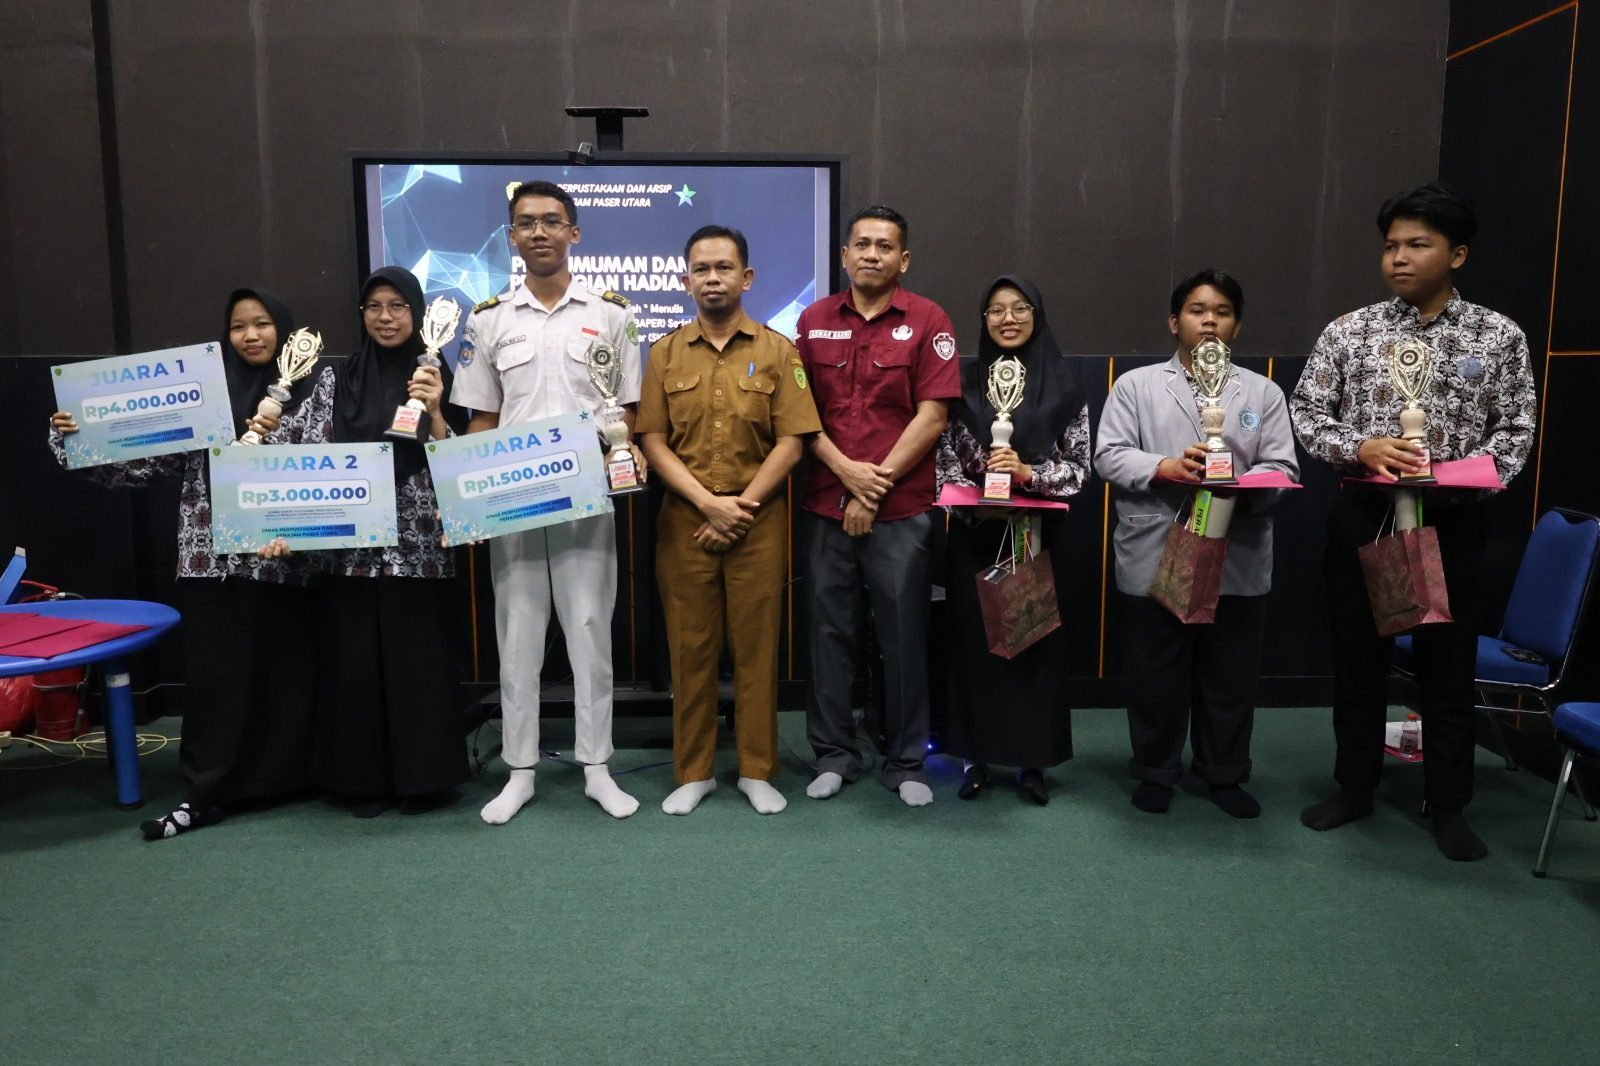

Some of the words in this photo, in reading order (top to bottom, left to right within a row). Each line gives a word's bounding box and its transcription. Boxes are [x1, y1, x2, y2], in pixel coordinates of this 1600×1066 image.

[626, 184, 646, 193] DAN
[646, 184, 673, 194] ARSIP
[593, 198, 621, 207] PASER
[622, 198, 651, 207] UTARA
[623, 275, 685, 291] HADIA
[650, 303, 684, 314] Menulis
[90, 362, 169, 386] JUARA
[176, 359, 185, 373] 1
[84, 389, 200, 419] Rp4.000.000
[462, 433, 542, 461] JUARA
[548, 428, 562, 443] 3
[249, 456, 335, 472] JUARA
[344, 455, 358, 470] 2
[464, 459, 573, 494] Rp1.500.000
[242, 487, 367, 506] Rp3.000.000
